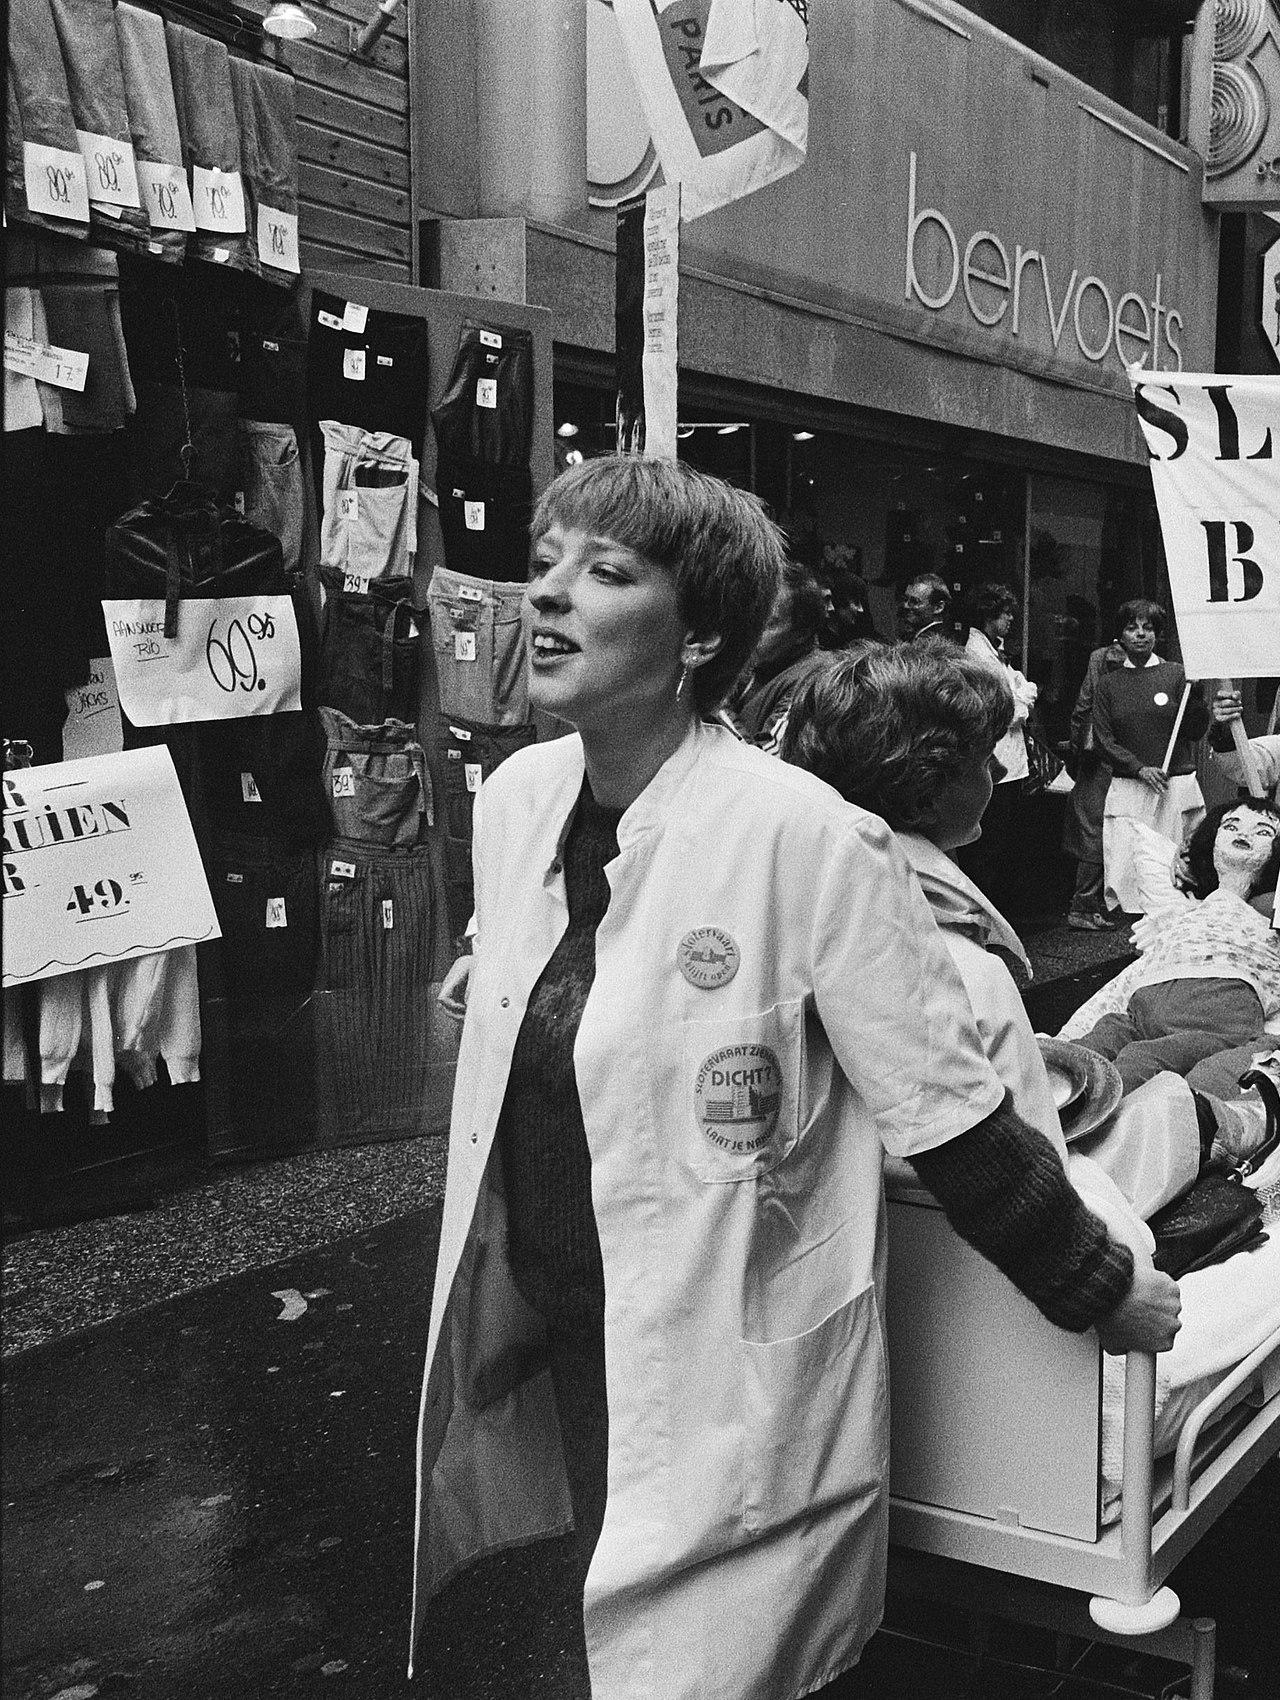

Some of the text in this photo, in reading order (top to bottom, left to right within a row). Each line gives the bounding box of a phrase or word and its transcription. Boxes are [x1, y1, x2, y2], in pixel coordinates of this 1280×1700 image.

[905, 151, 1184, 373] bervoets
[695, 1046, 748, 1095] SLOTERVAART
[711, 1066, 772, 1087] DICHT?
